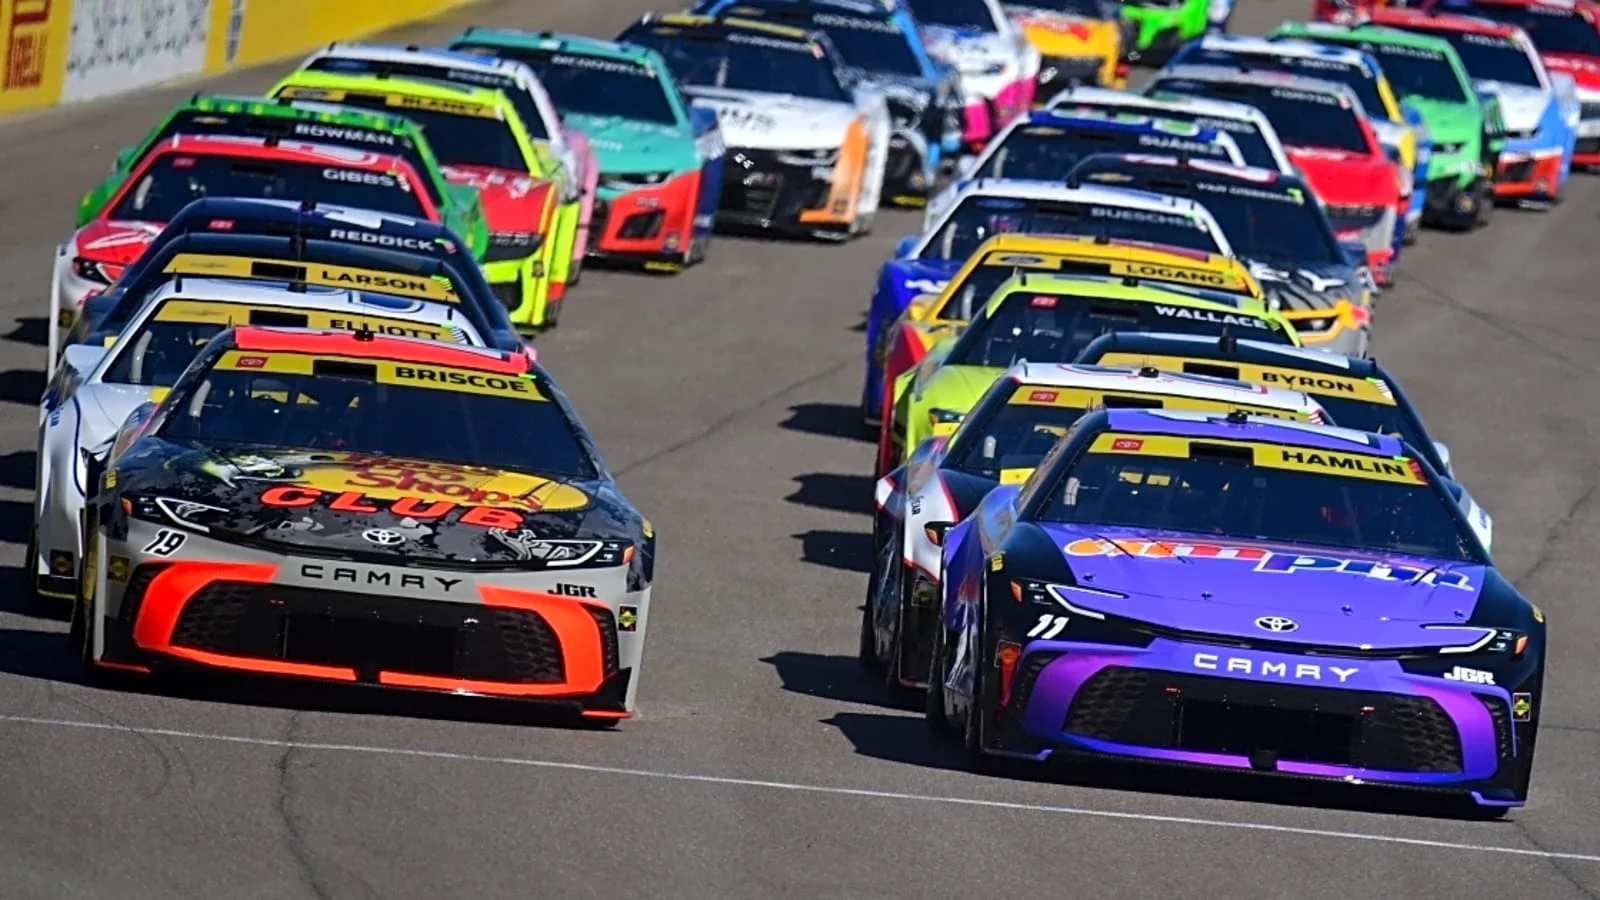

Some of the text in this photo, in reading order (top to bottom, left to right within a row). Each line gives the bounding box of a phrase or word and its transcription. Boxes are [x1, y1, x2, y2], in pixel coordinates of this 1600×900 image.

[295, 123, 395, 146] BOWMAN
[322, 168, 395, 188] GIBBS
[329, 228, 435, 252] REDDICK
[321, 269, 428, 293] LARSON
[1125, 264, 1226, 286] LOGANO
[329, 318, 441, 340] ELLIOTT
[1155, 305, 1268, 330] WALLACE
[395, 366, 529, 394] BRISCOE
[1262, 371, 1356, 393] BYRON
[1281, 450, 1406, 477] HAMLIN
[260, 484, 525, 531] CLUB
[143, 529, 188, 557] 19
[301, 564, 463, 592] CAMRY
[547, 583, 598, 598] JGR
[1026, 613, 1070, 640] 11
[1193, 652, 1360, 682] CAMRY
[1443, 666, 1496, 686] JGR
